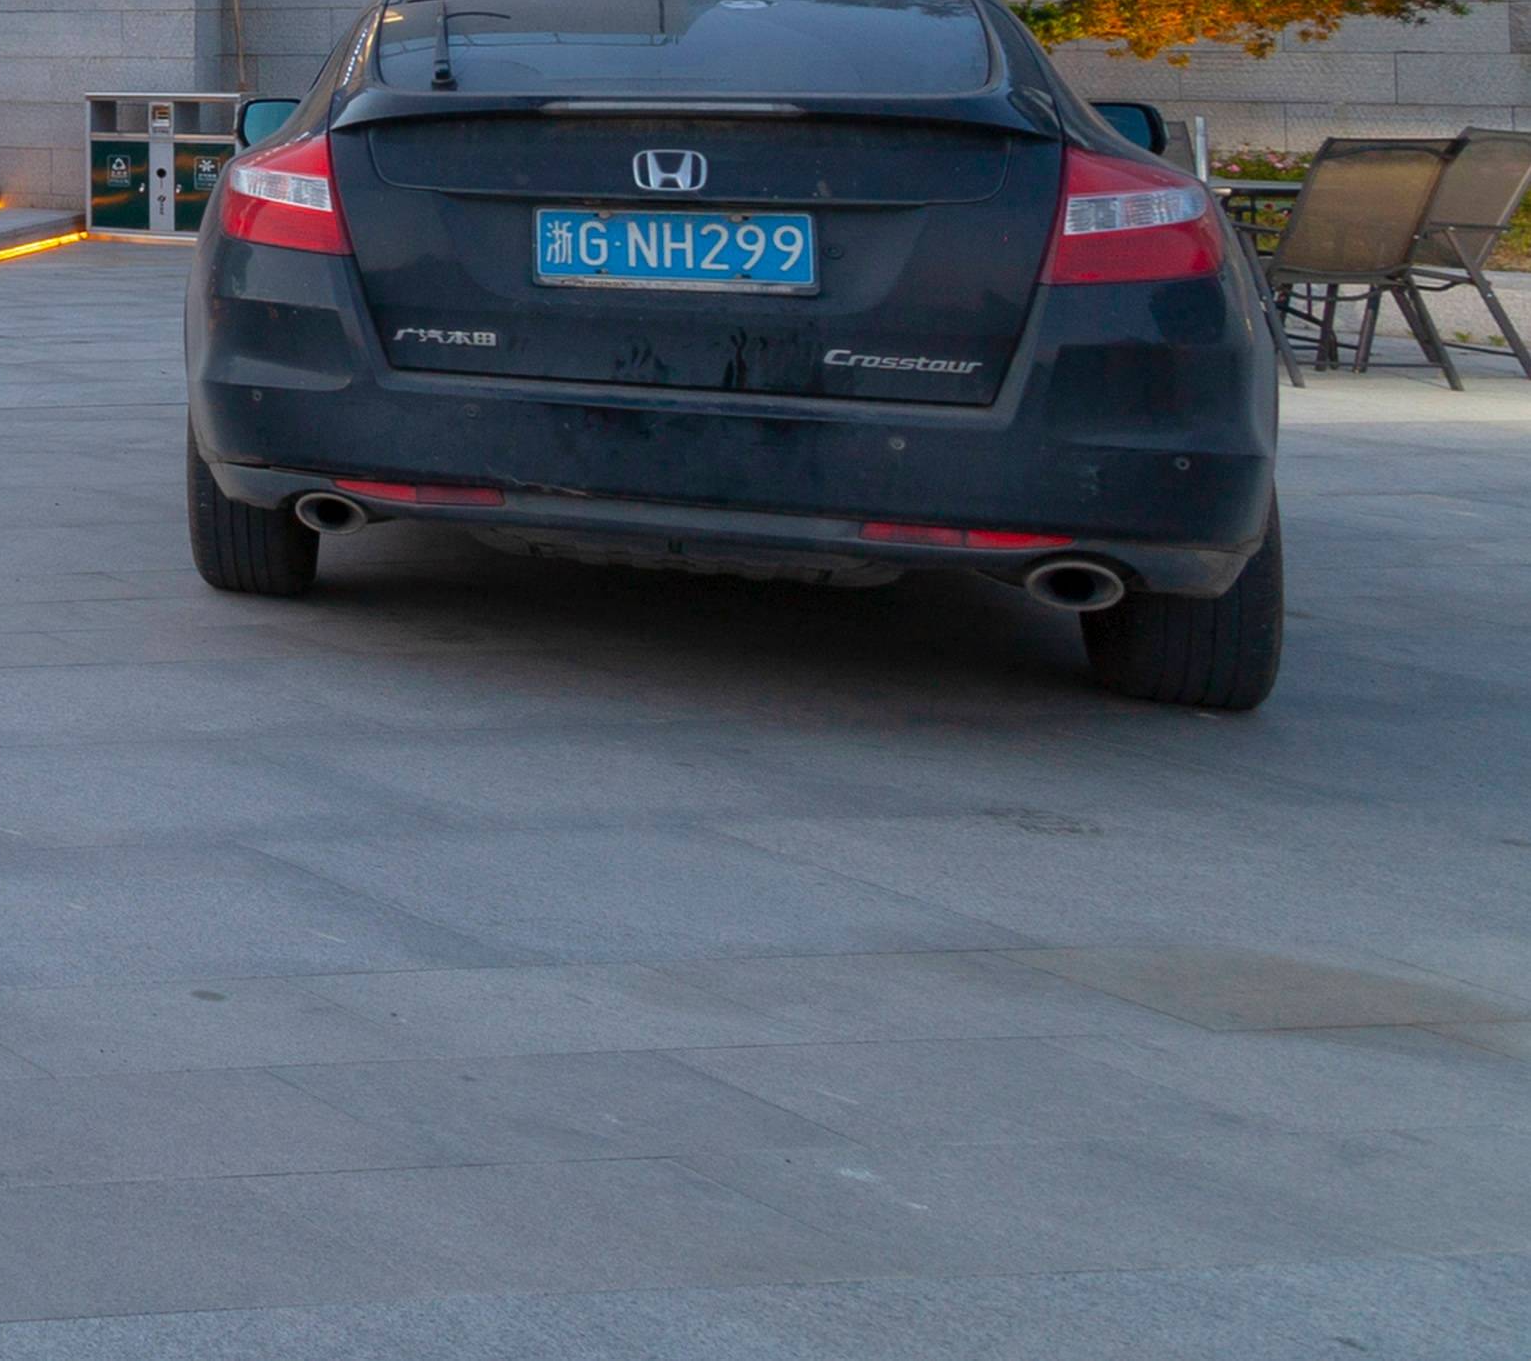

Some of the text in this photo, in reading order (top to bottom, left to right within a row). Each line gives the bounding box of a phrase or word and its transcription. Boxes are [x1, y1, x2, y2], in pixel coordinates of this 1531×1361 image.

[393, 327, 497, 347] 广汽本田
[823, 348, 983, 375] Crosstour
